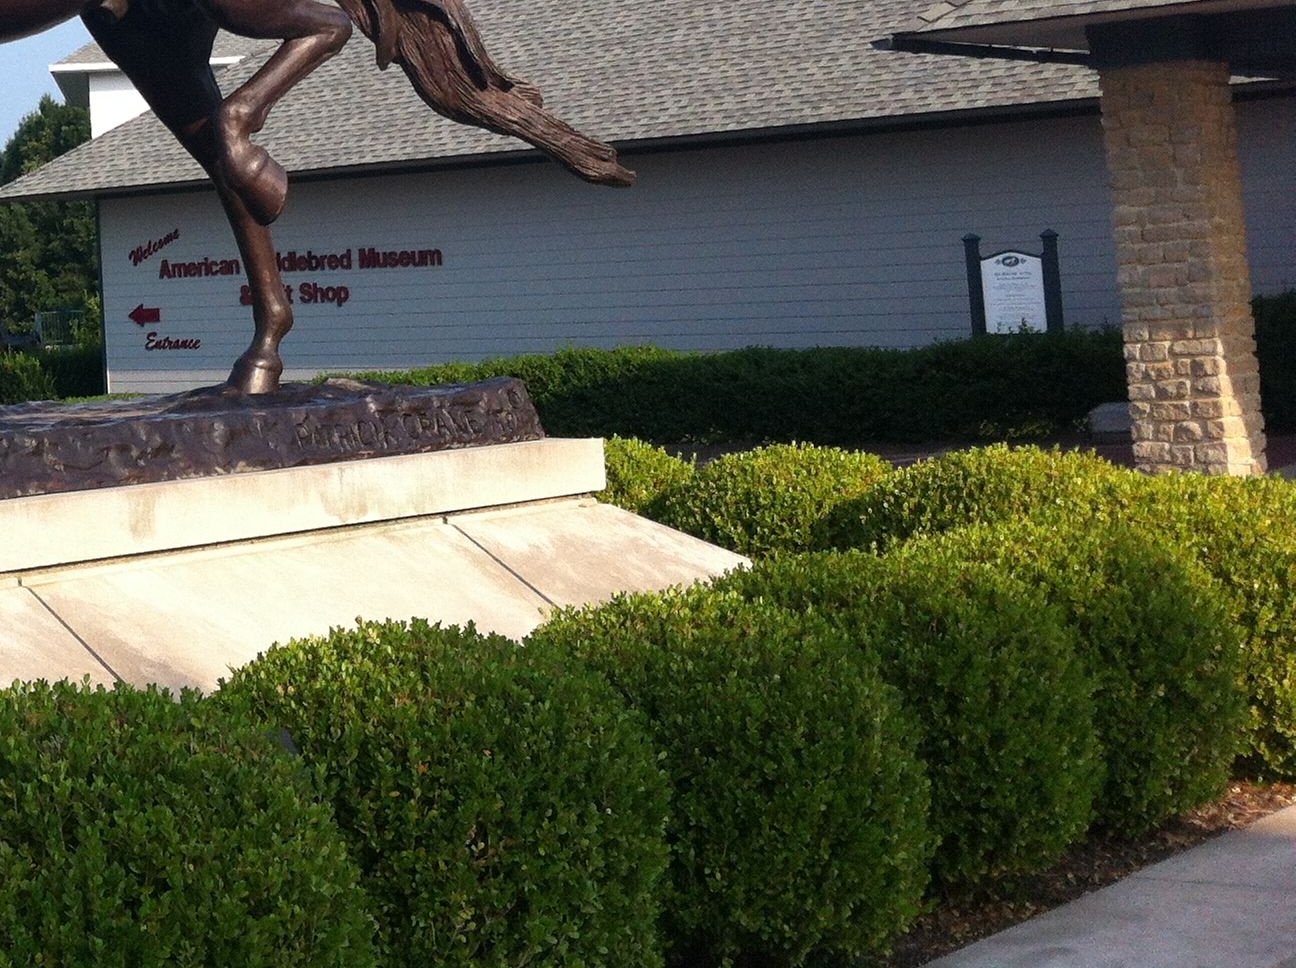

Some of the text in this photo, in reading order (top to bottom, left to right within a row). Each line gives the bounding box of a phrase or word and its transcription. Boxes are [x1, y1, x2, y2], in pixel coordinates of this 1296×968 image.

[129, 228, 181, 267] Welcome
[159, 257, 240, 279] American
[358, 247, 443, 270] Museum
[299, 282, 349, 307] Shop
[144, 331, 201, 351] Entrance
